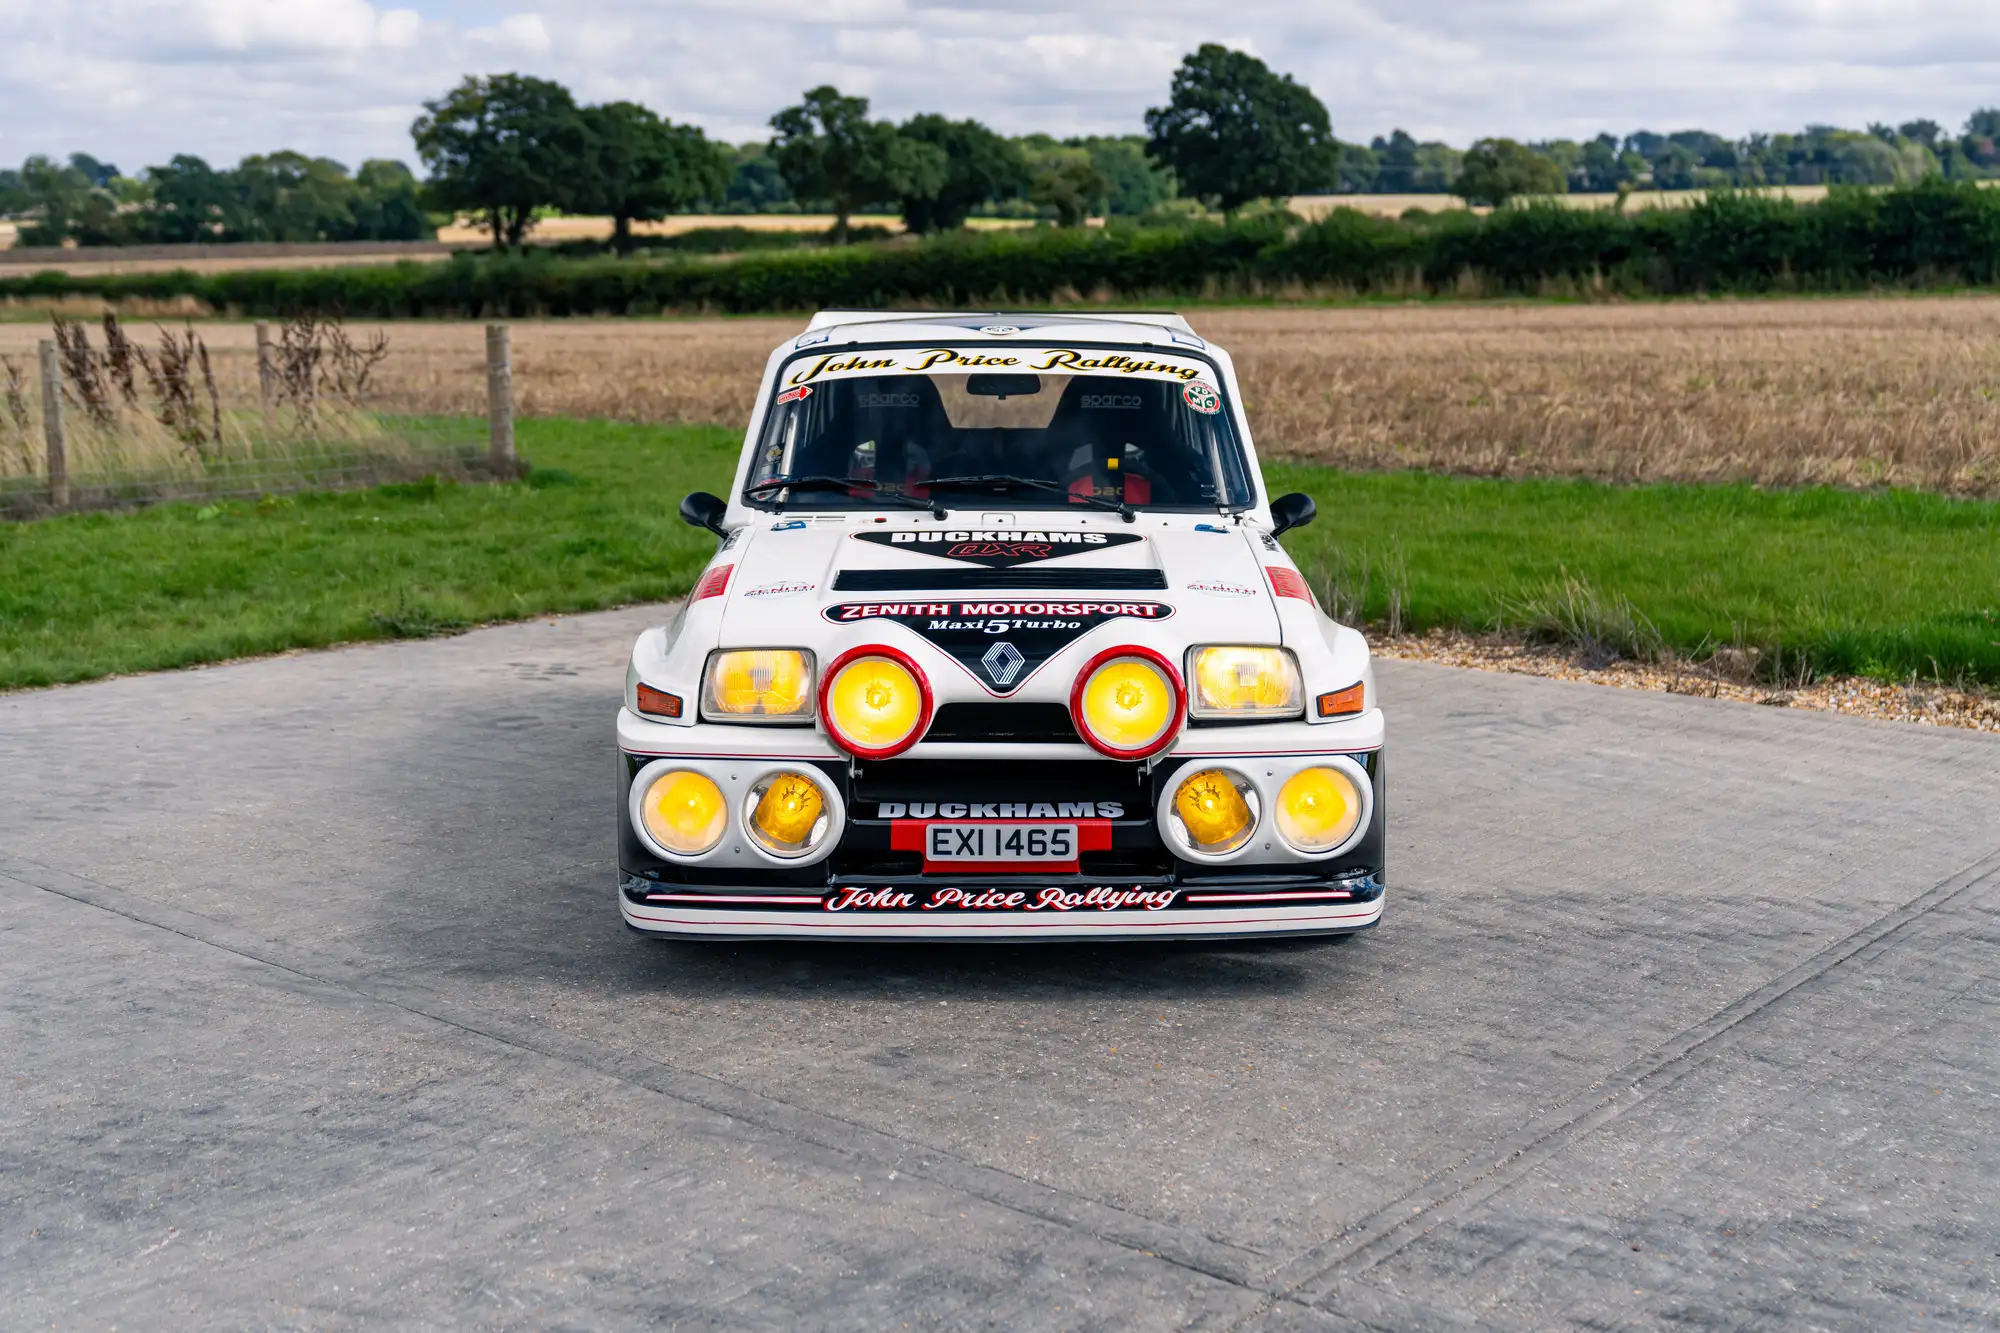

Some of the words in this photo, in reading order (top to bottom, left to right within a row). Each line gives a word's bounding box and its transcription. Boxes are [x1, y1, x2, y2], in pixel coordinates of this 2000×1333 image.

[789, 354, 898, 385] John
[903, 348, 1022, 371] Price
[1027, 349, 1203, 379] Rallying
[859, 393, 920, 408] sparco
[1081, 393, 1142, 408] sparco
[891, 531, 1107, 544] DUCKHAMS
[947, 542, 1052, 557] QXR
[841, 603, 949, 619] ZENITH
[959, 603, 1160, 617] MOTORSPORT
[878, 801, 1125, 819] DUCKHAMS
[995, 828, 1071, 856] 1465
[824, 886, 916, 911] John
[921, 887, 1026, 910] Price
[1023, 885, 1182, 911] Rallying
